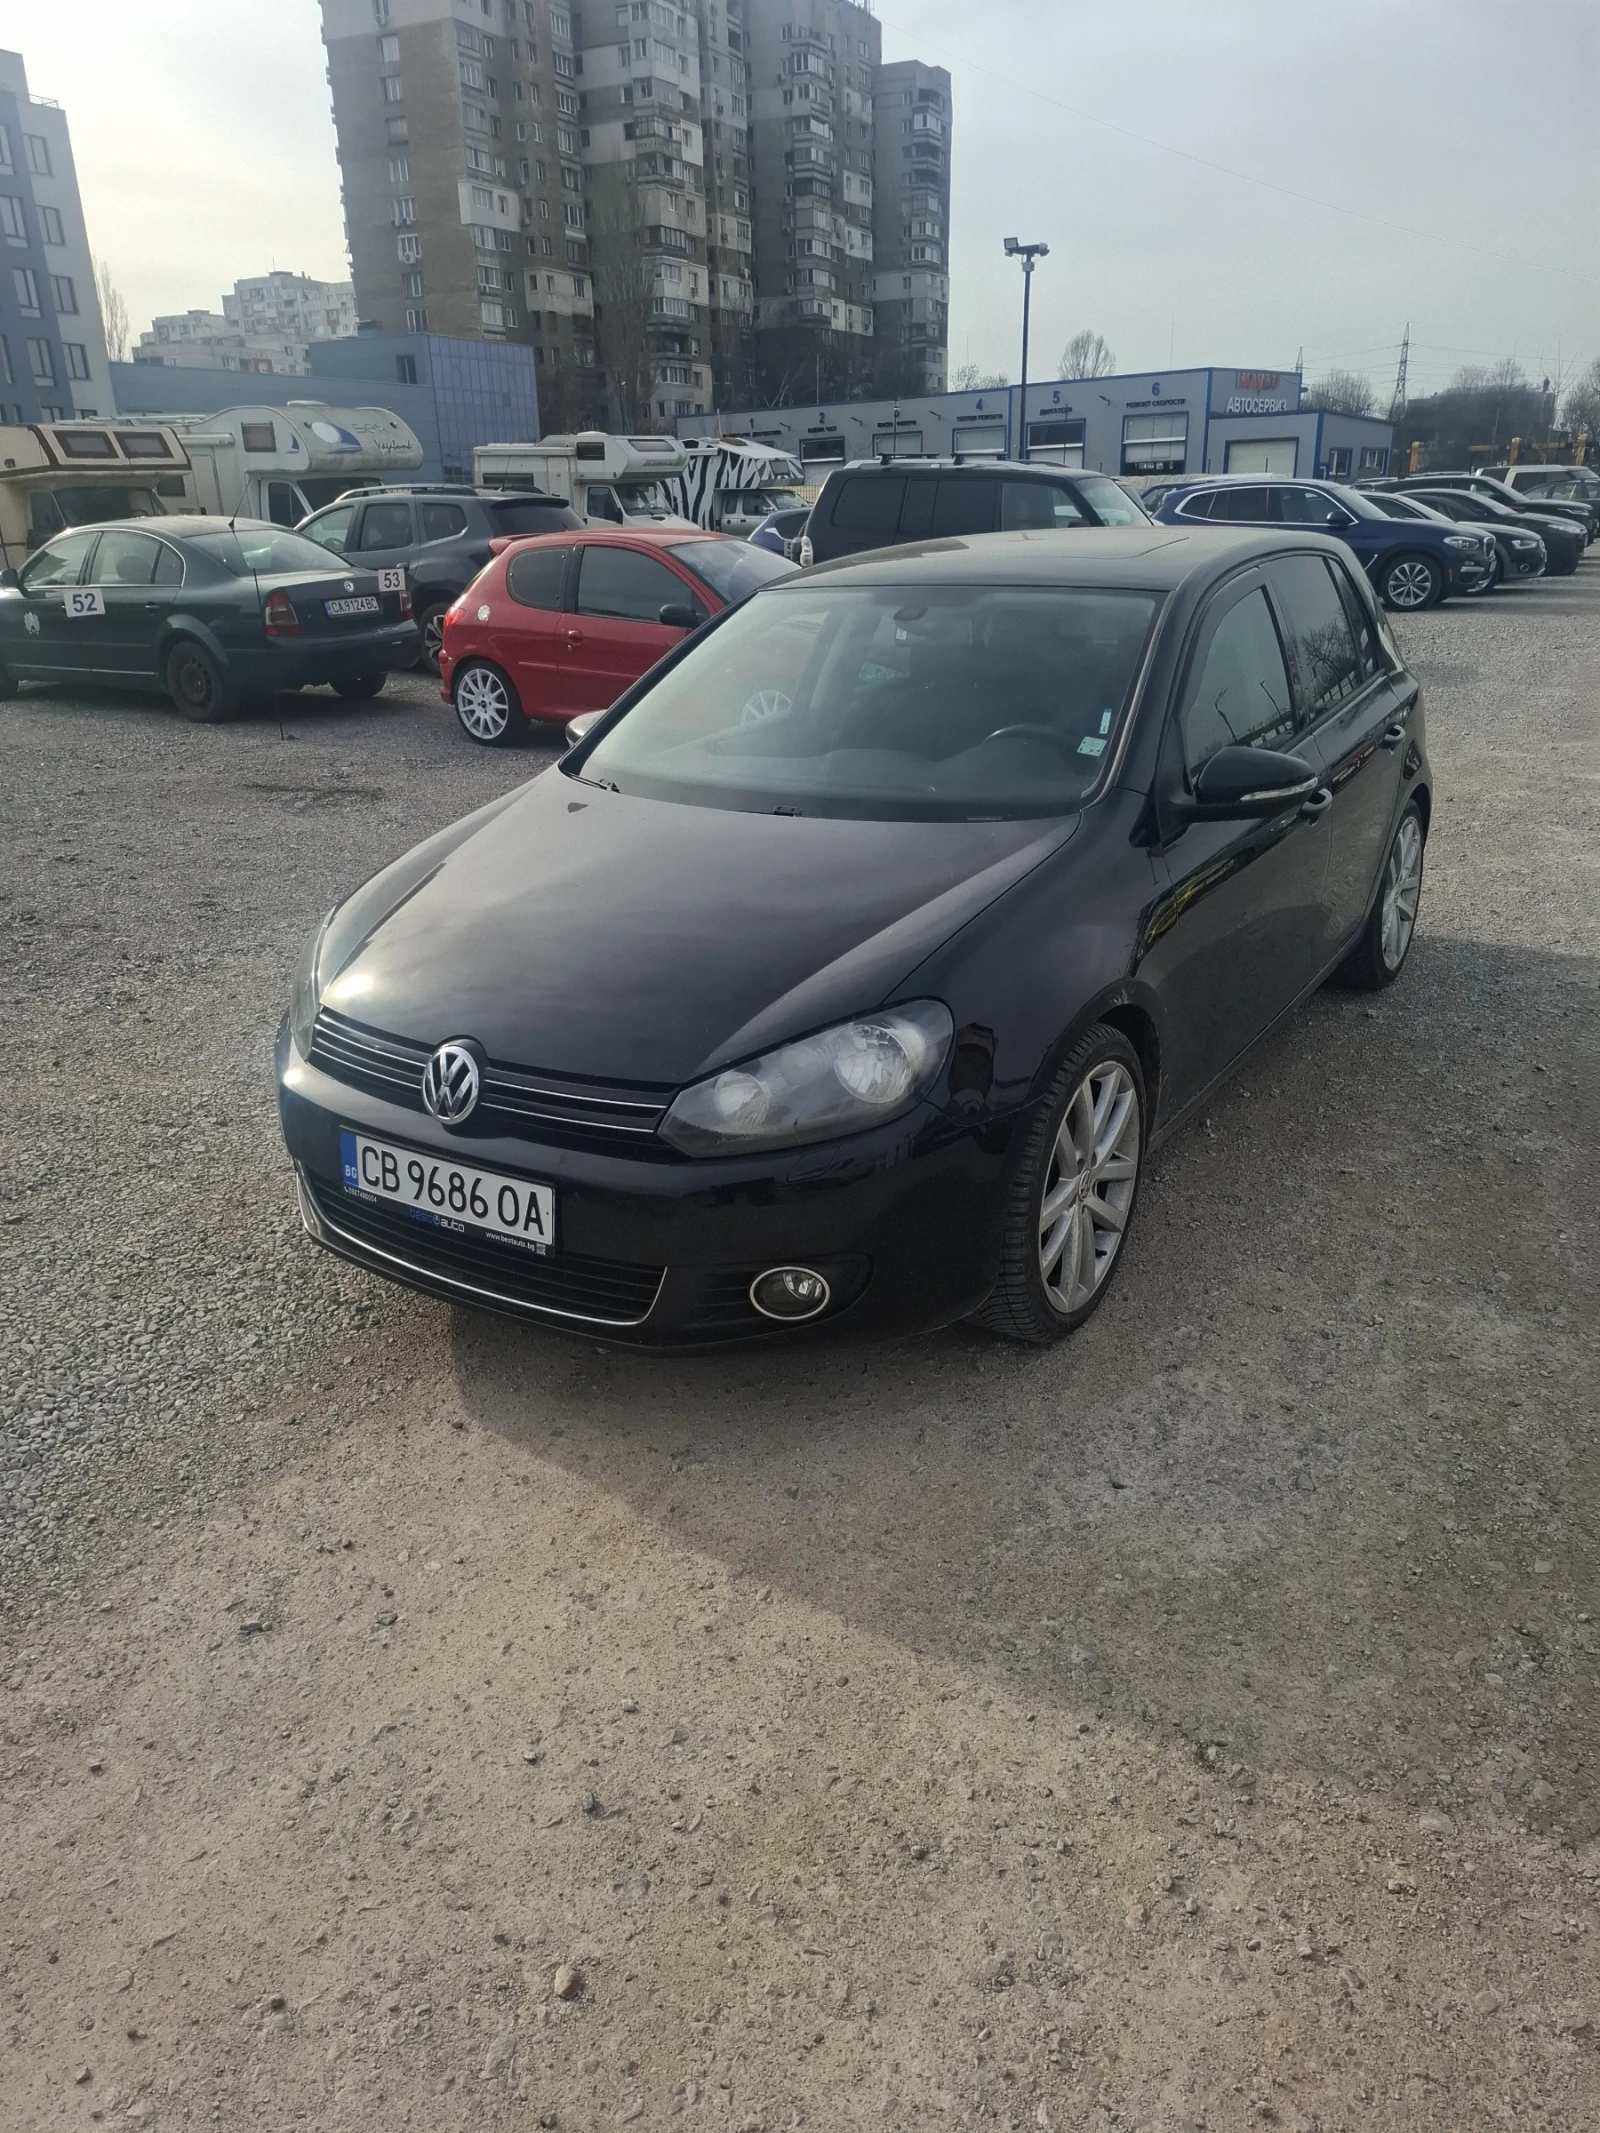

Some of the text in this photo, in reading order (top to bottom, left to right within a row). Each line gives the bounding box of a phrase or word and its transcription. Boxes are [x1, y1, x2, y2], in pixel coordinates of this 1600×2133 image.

[1151, 382, 1160, 396] 6
[1052, 390, 1061, 404] 5
[975, 398, 984, 411] 4
[1226, 396, 1287, 413] АВТОСЕРВИЗ
[749, 417, 755, 429] 1
[818, 411, 826, 424] 2
[384, 572, 400, 588] 53
[73, 593, 97, 613] 52
[345, 1165, 358, 1179] BG
[485, 1231, 535, 1251] www.bestauto.bg
